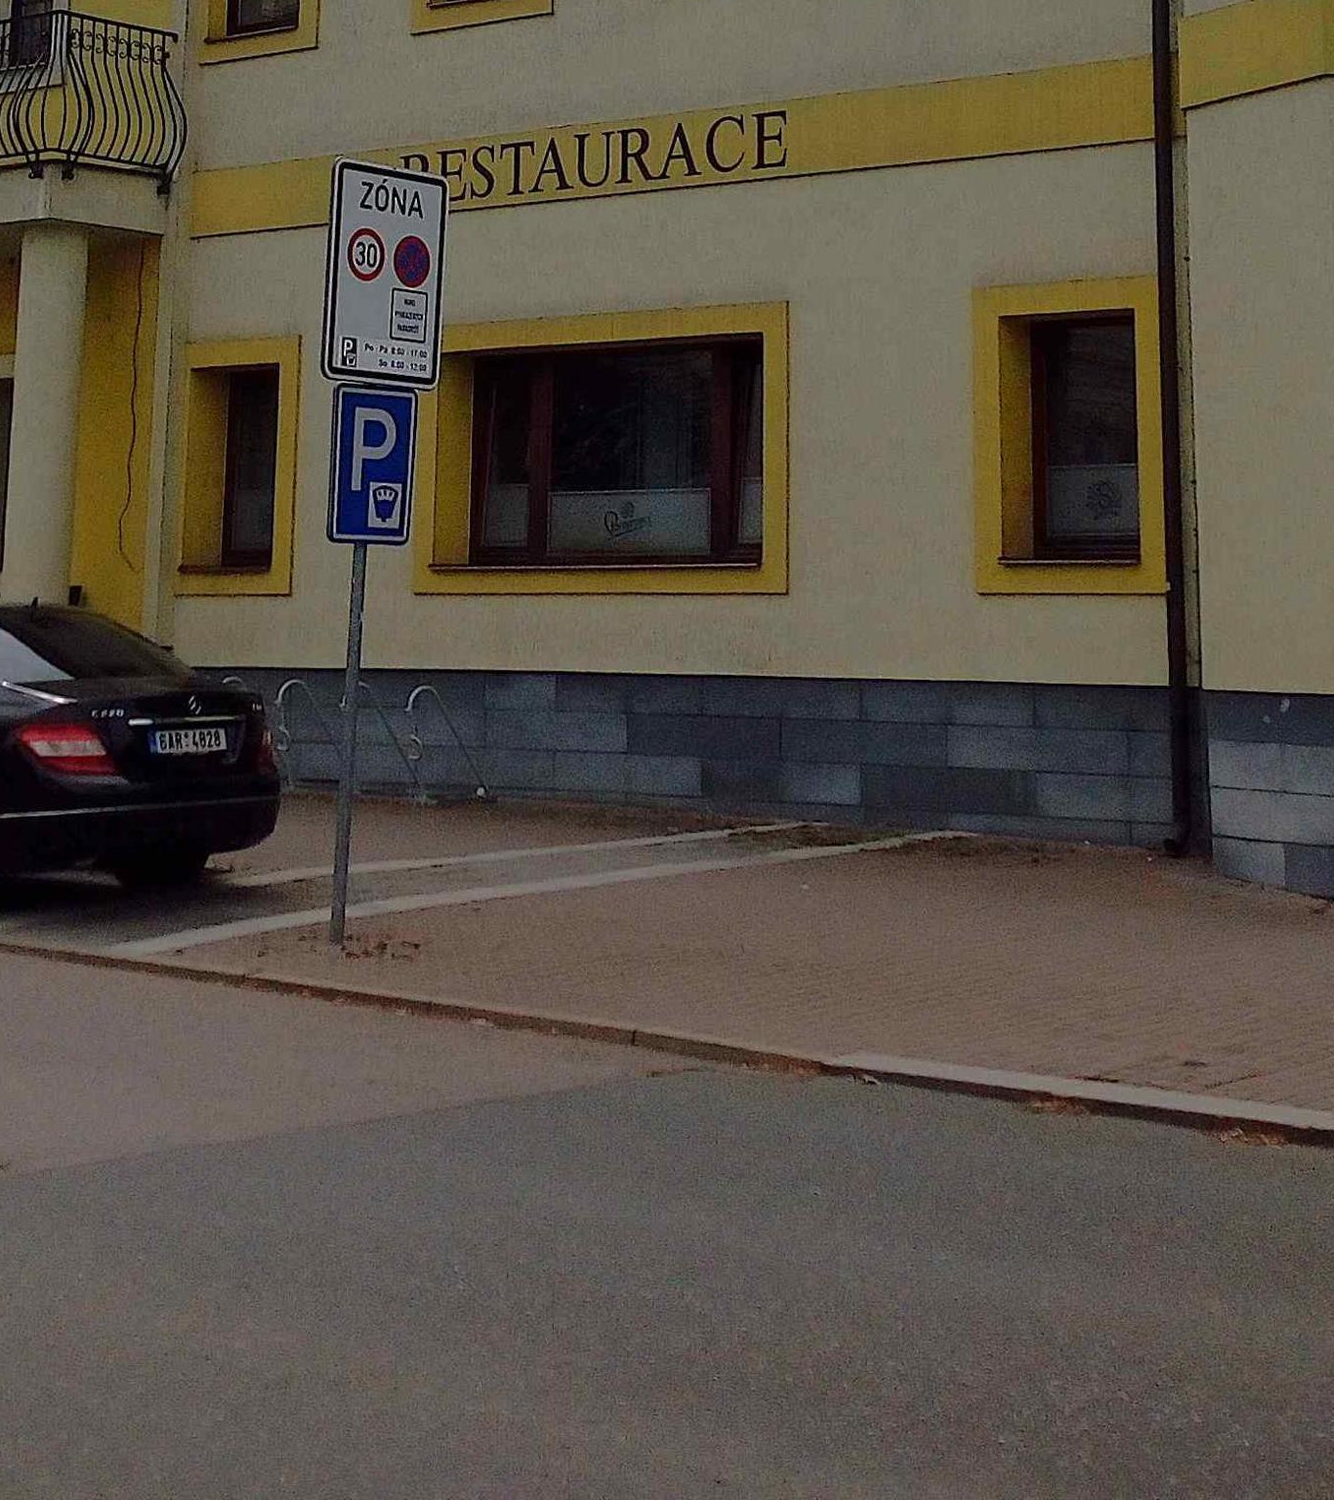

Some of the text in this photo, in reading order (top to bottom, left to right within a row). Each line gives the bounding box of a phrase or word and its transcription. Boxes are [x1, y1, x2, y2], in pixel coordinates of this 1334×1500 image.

[359, 179, 424, 220] ZÓNA
[355, 240, 378, 269] 30
[351, 405, 397, 492] P
